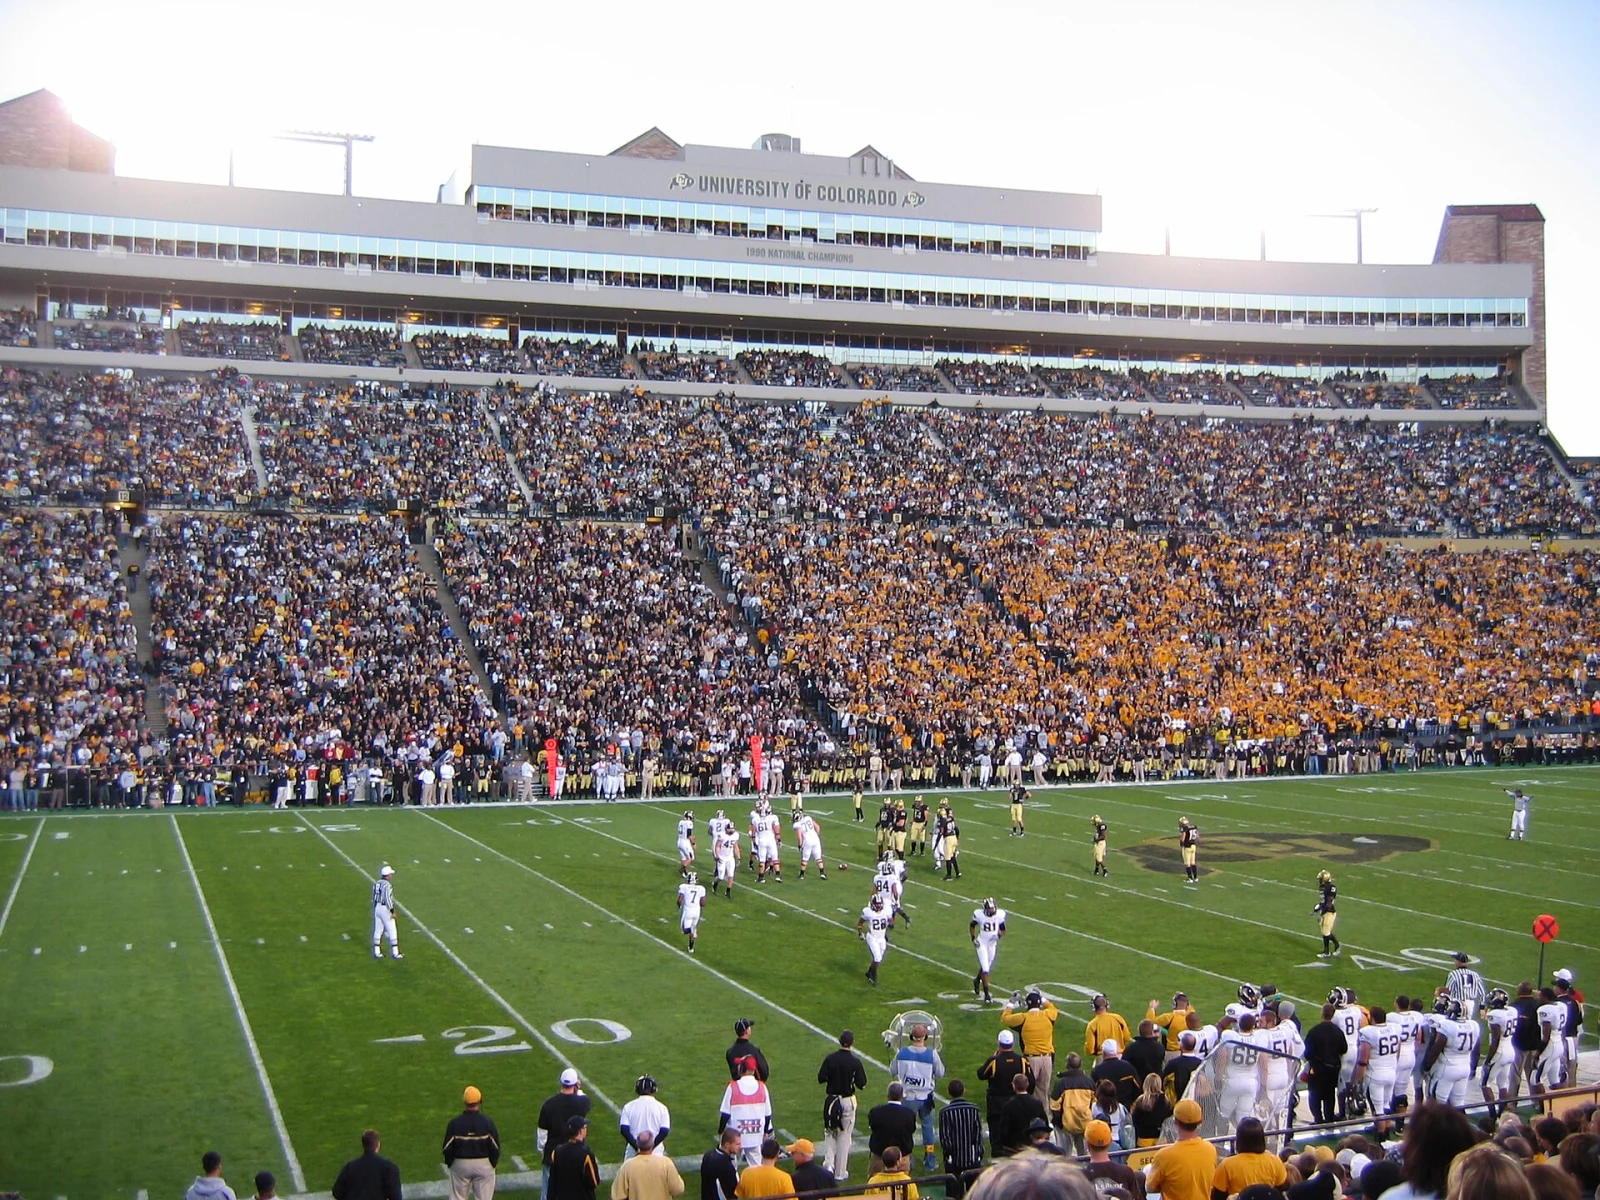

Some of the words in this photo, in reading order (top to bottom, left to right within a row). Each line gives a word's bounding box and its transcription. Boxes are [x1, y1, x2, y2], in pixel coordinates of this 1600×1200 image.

[698, 175, 789, 199] UNIVERSITY
[795, 183, 812, 200] OF
[817, 185, 897, 206] COLORADO
[746, 247, 766, 258] 1990
[768, 249, 805, 261] NATIONAL
[808, 251, 854, 263] CHAMPIONS
[119, 491, 129, 501] 12
[758, 821, 768, 832] 61
[801, 820, 814, 832] 78
[723, 840, 735, 849] 45
[876, 880, 890, 892] 84
[690, 890, 697, 903] 7
[872, 919, 887, 931] 28
[983, 922, 996, 932] 81
[1345, 1016, 1354, 1035] 8
[1401, 1023, 1418, 1042] 54
[441, 1018, 632, 1056] 20
[1379, 1034, 1399, 1056] 62
[1457, 1032, 1473, 1051] 71
[1199, 1038, 1208, 1057] 4
[1233, 1046, 1258, 1065] 68
[1273, 1039, 1288, 1059] 51
[904, 1076, 922, 1086] FSN
